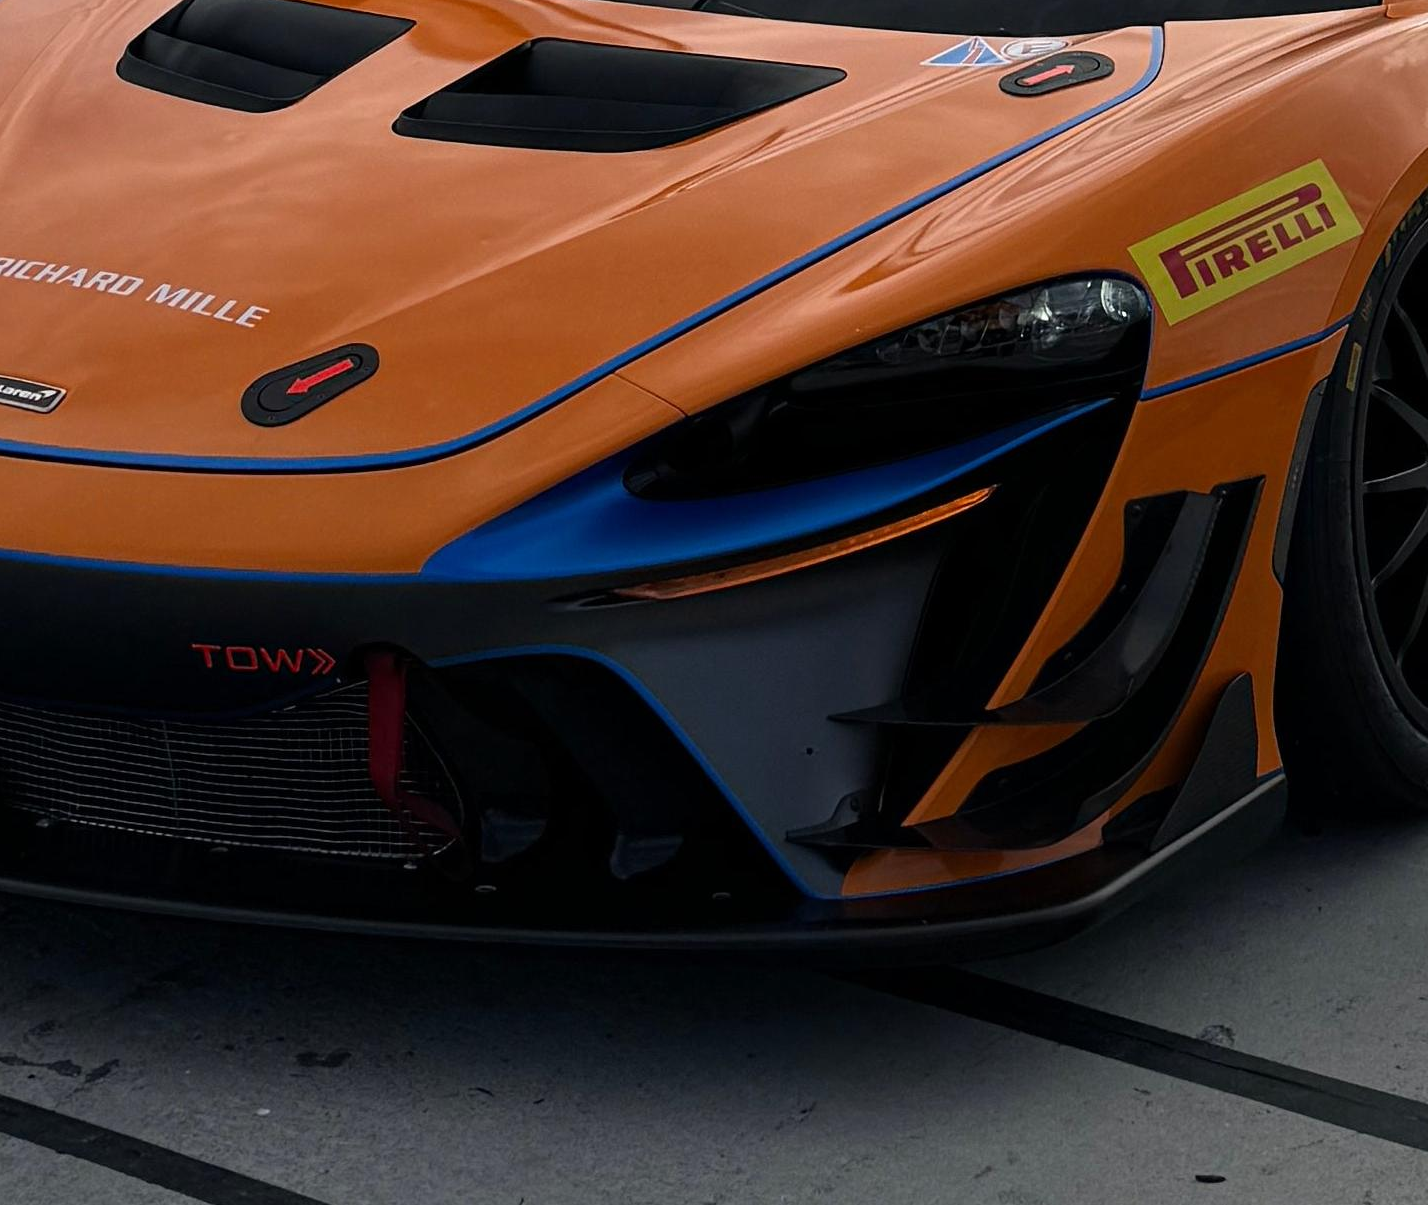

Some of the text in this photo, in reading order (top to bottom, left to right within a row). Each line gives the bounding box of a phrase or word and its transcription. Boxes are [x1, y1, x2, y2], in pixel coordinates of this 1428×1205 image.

[1158, 182, 1338, 299] PIRELLI
[145, 283, 271, 329] MILLE
[190, 643, 304, 674] TOW
